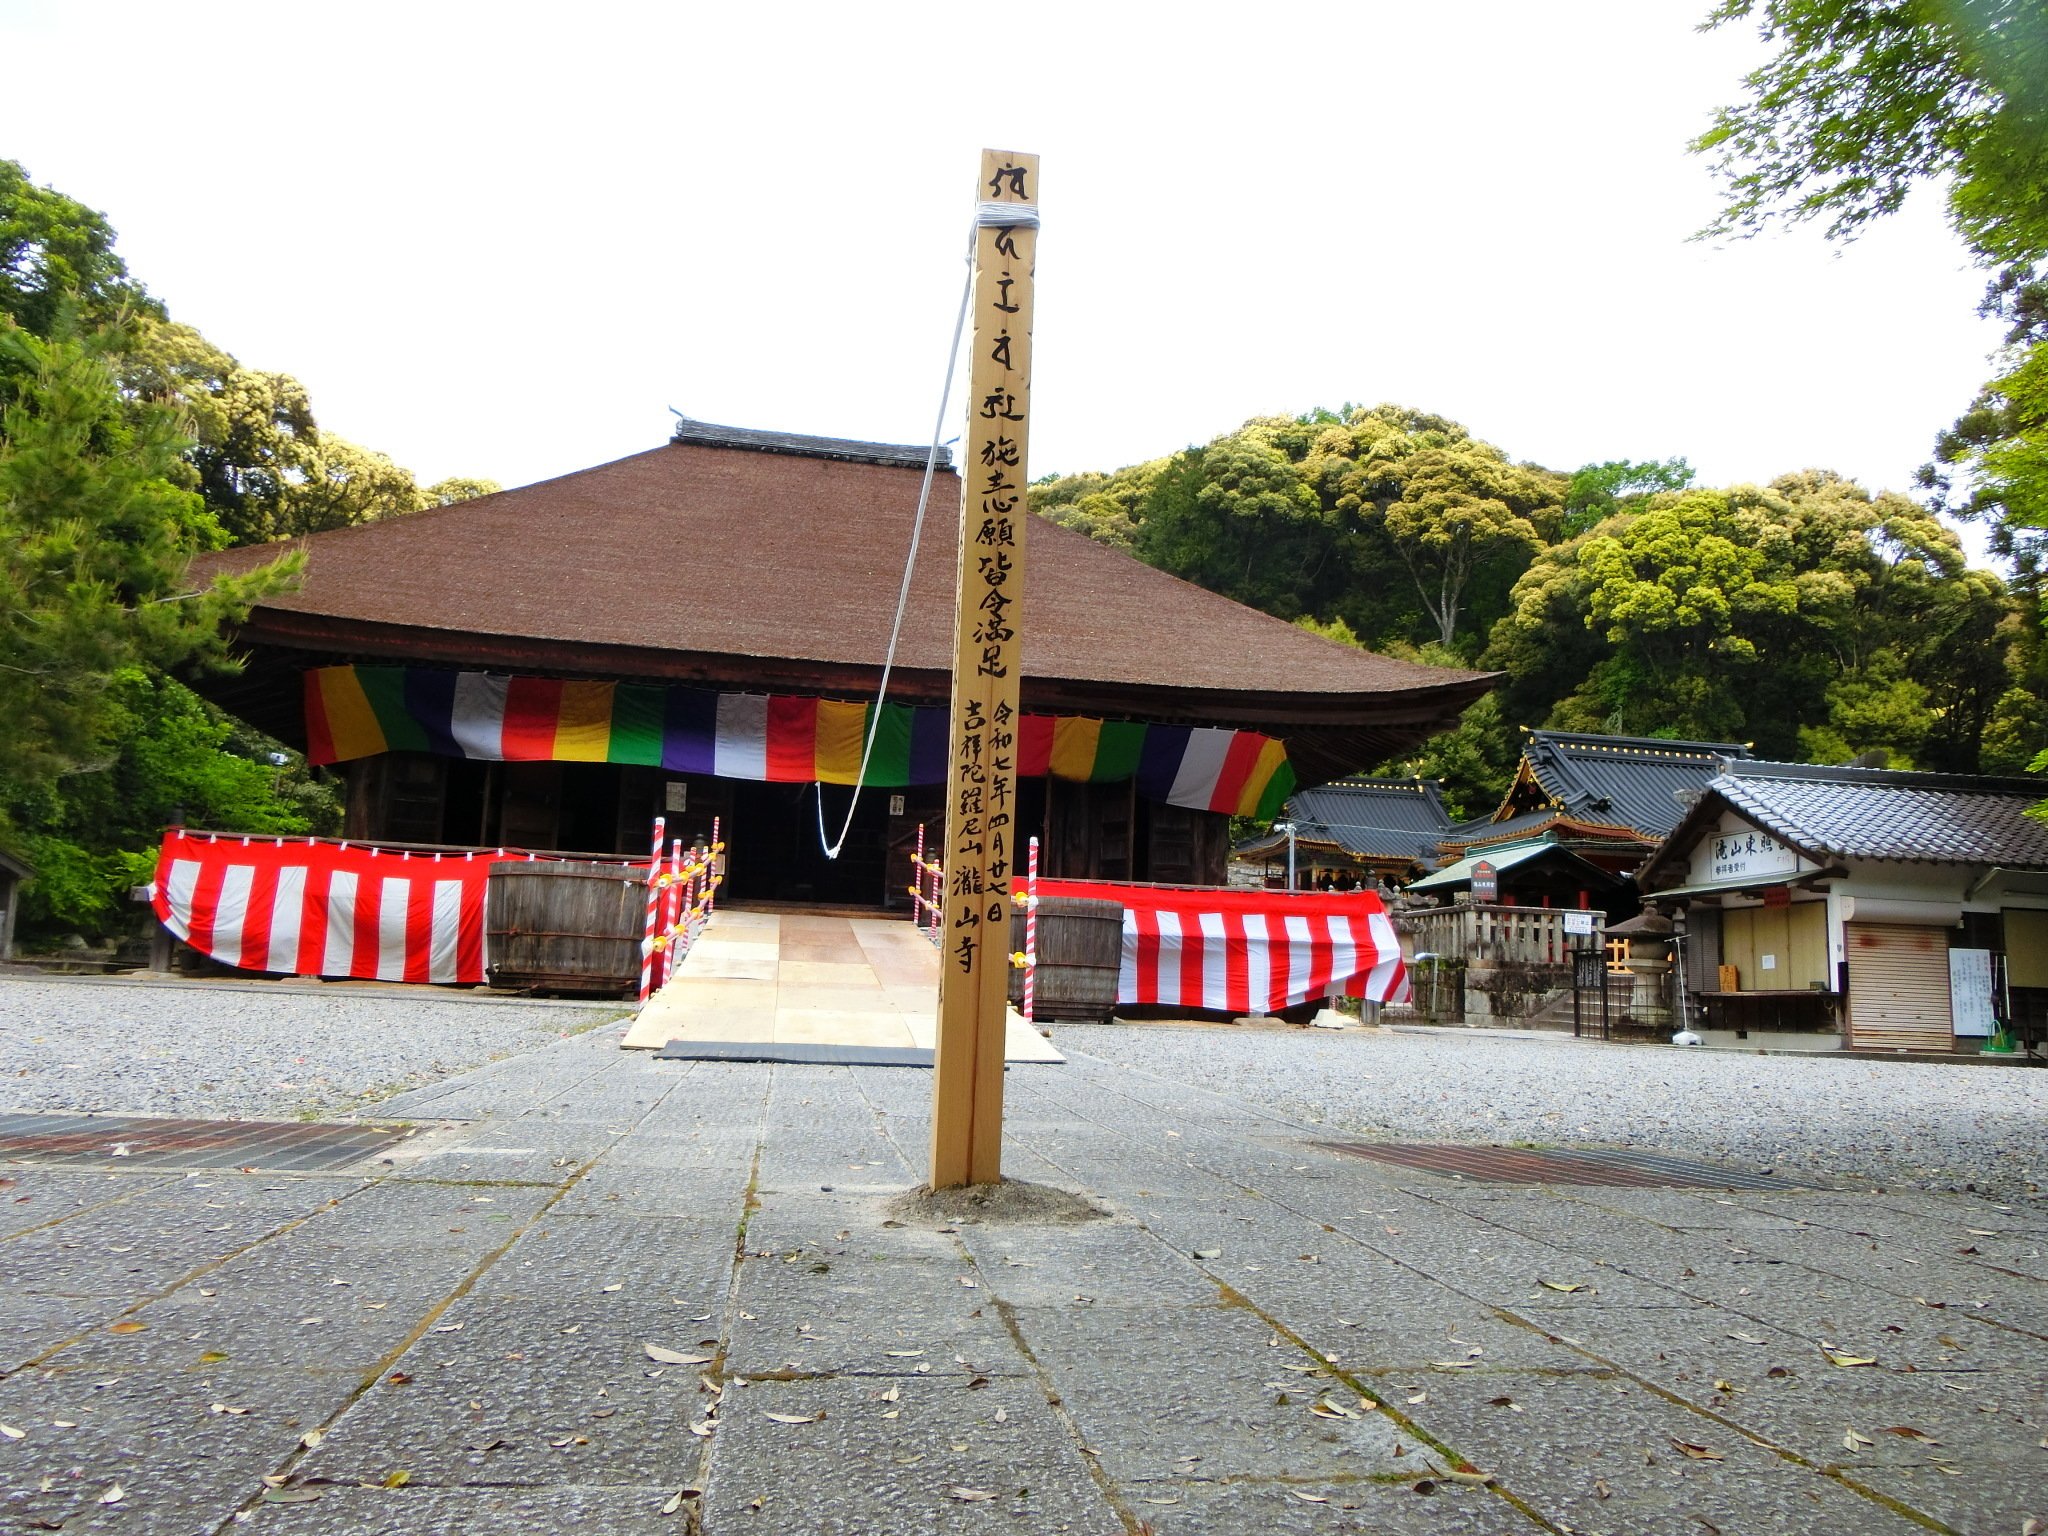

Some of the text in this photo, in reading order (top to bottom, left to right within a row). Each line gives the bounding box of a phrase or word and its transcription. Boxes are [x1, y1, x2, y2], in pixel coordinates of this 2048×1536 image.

[985, 698, 1013, 922] 令和七年四月廿七日
